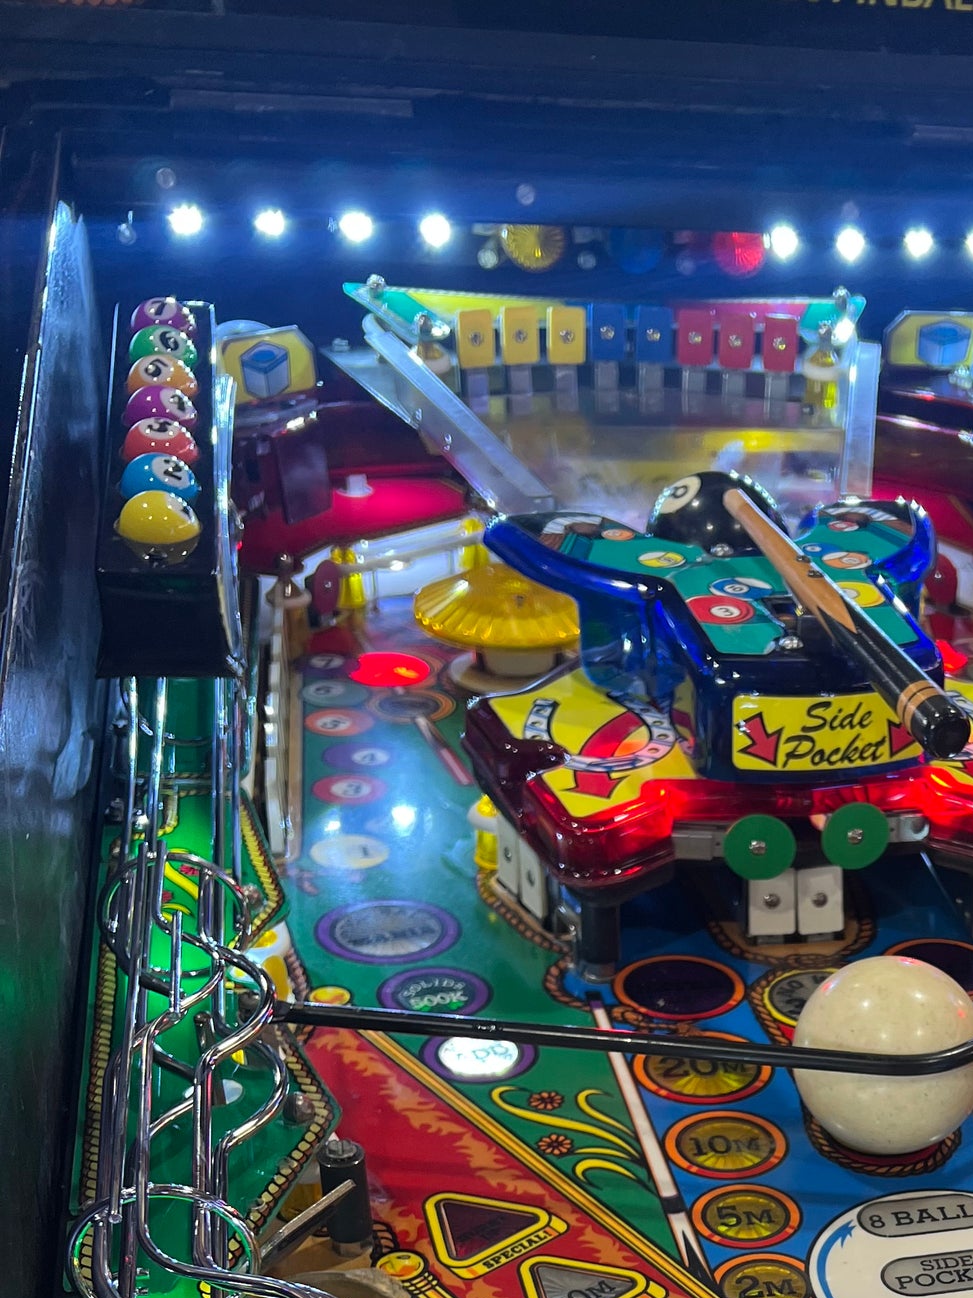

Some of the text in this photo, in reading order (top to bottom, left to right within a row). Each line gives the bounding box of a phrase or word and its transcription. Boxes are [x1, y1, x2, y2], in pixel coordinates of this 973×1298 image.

[801, 701, 873, 733] Side
[783, 735, 887, 768] Pocket
[403, 978, 467, 998] SOLIDS
[688, 1132, 763, 1158] 10M
[716, 1204, 776, 1233] 5M
[869, 1215, 885, 1231] 8
